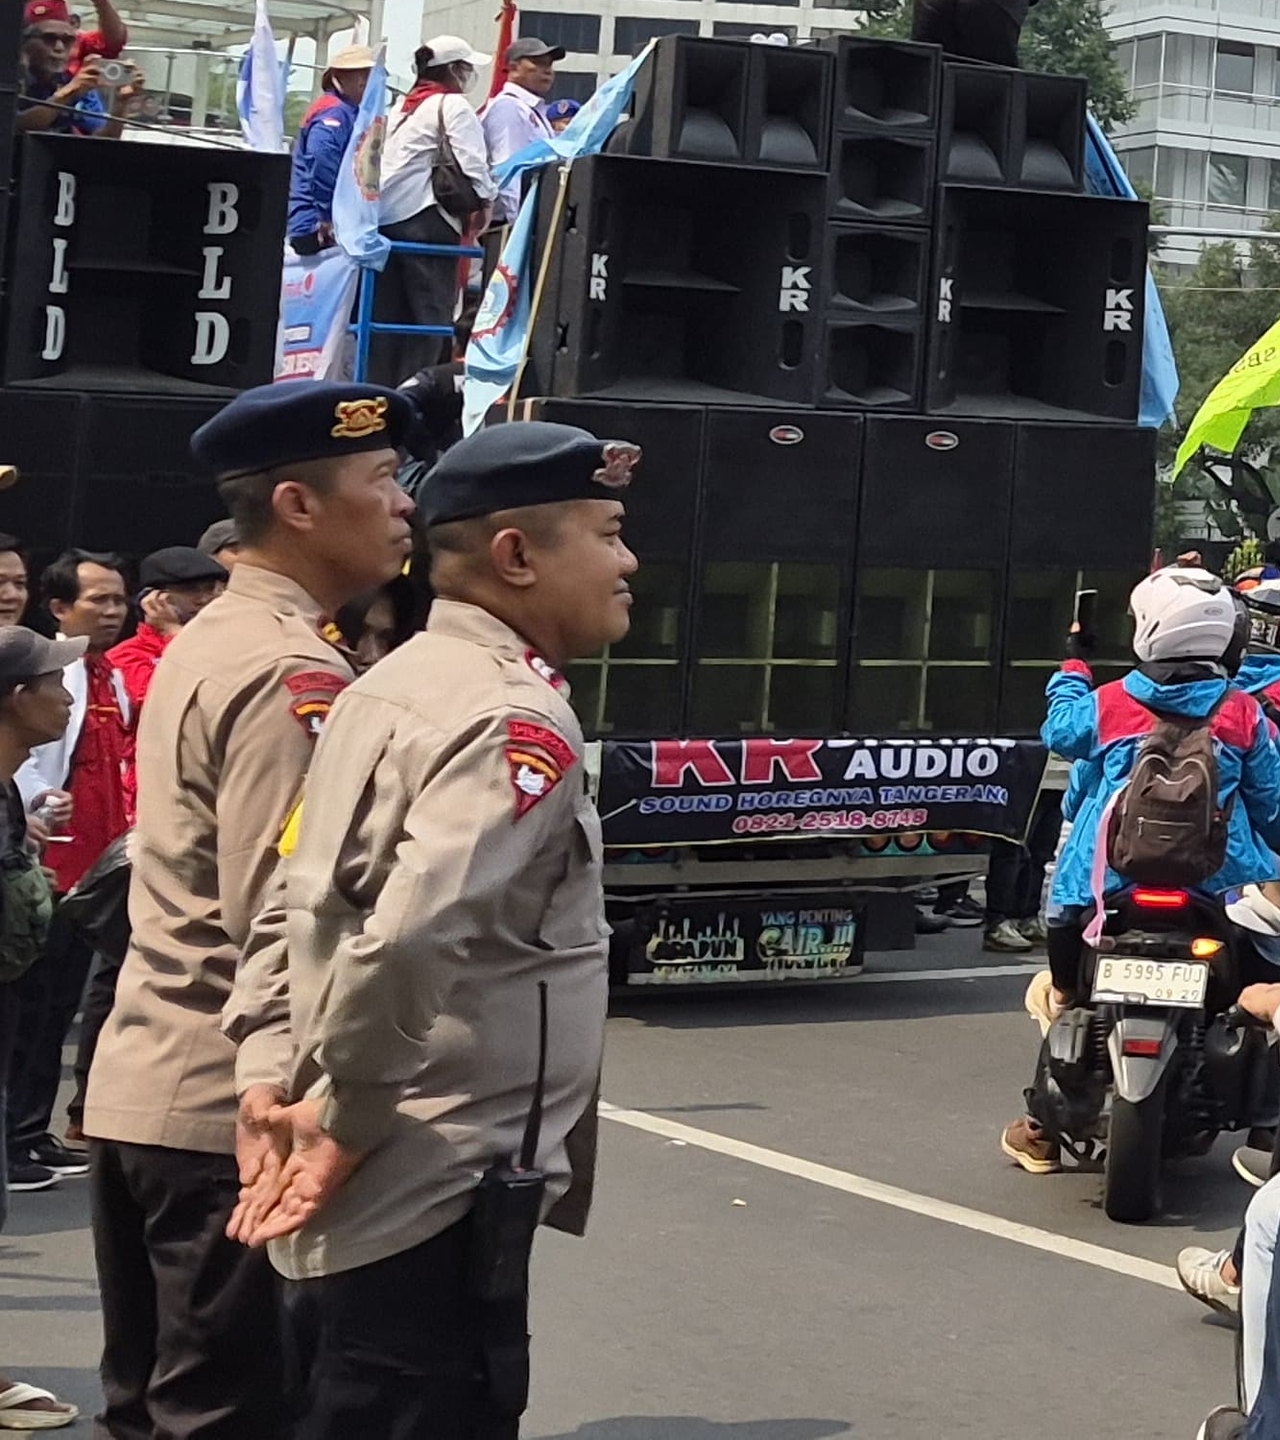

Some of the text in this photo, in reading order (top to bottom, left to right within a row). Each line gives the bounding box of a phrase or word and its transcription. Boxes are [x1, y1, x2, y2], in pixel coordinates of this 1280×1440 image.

[42, 171, 77, 360] BLD
[190, 182, 239, 365] BLD
[779, 266, 814, 312] KR
[1103, 289, 1135, 331] KR
[843, 748, 1000, 779] AUDIO
[639, 793, 733, 813] SOUND
[736, 788, 874, 809] HOREGNYA
[760, 909, 853, 926] YANG PENTING
[1103, 962, 1204, 983] B 5995 FUJ
